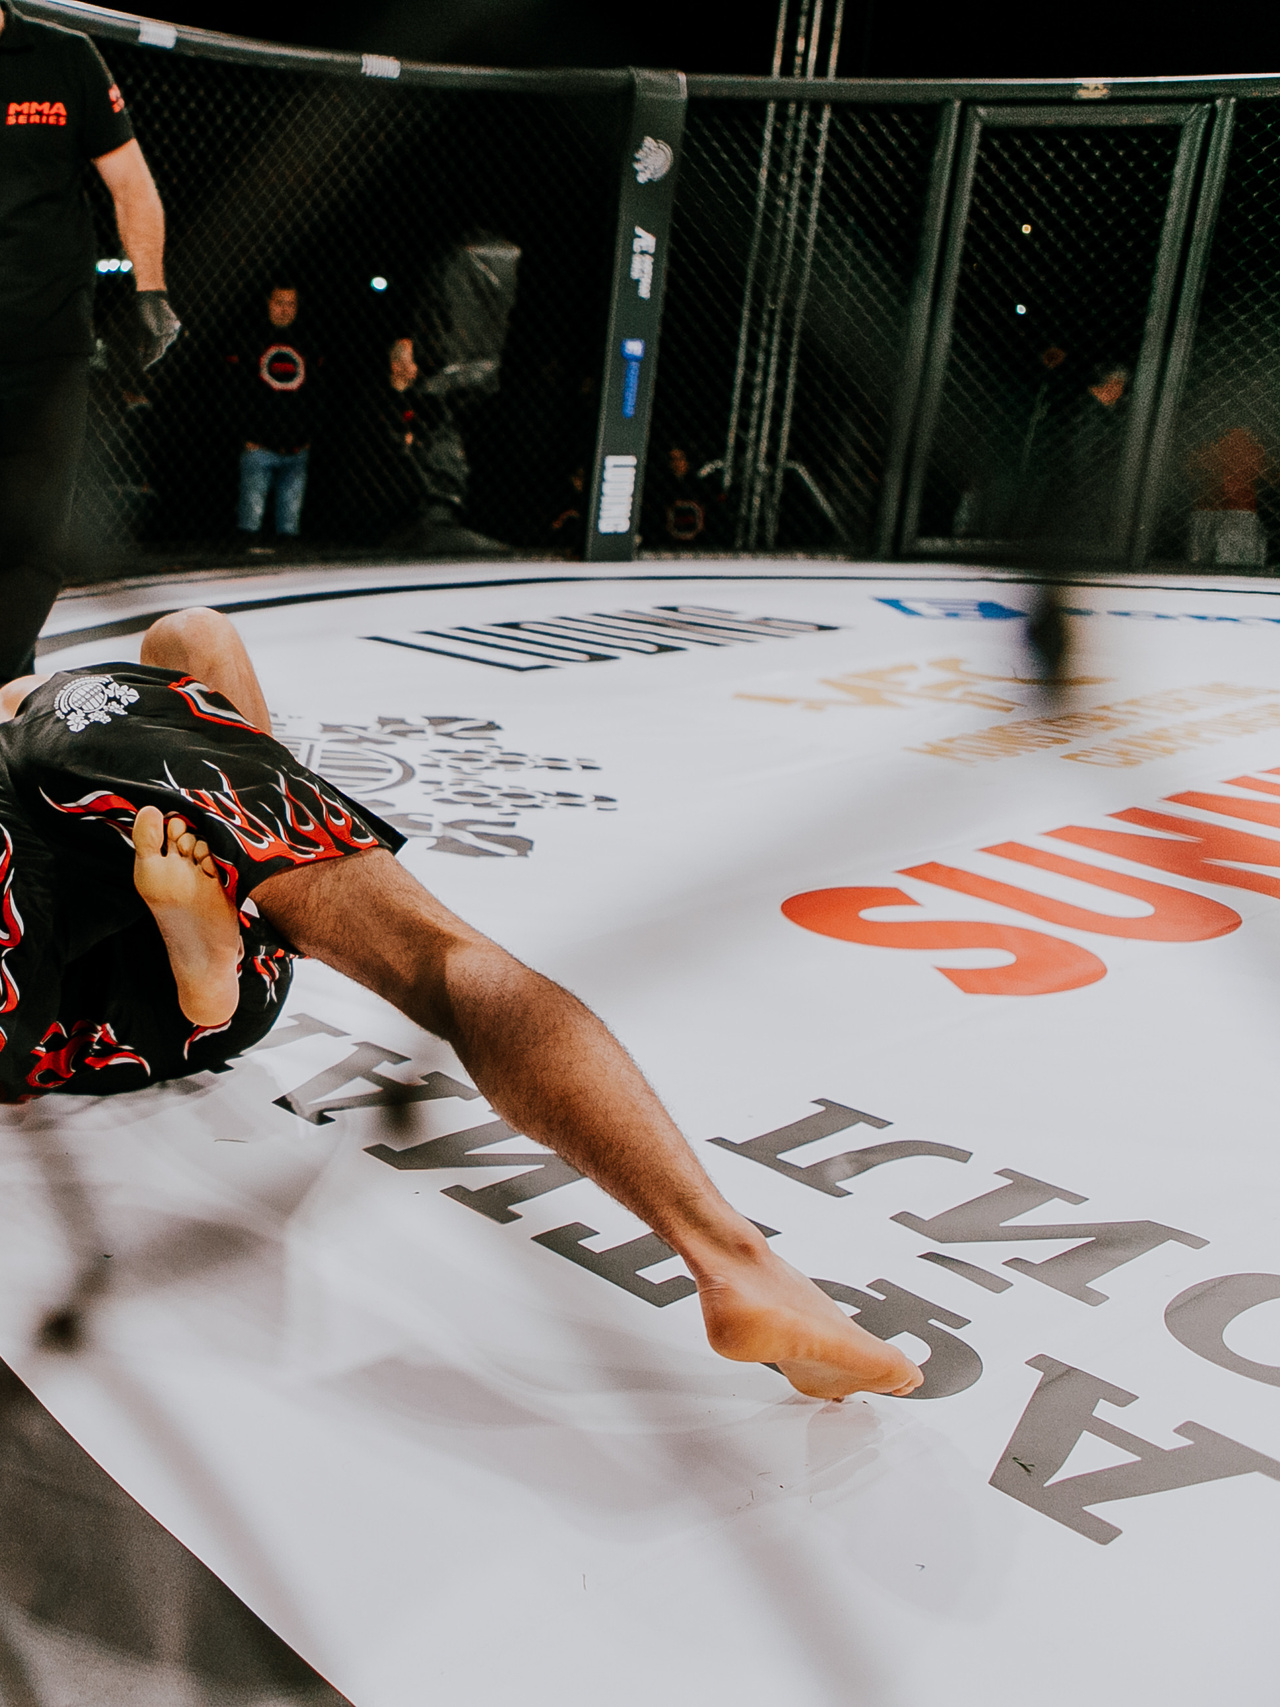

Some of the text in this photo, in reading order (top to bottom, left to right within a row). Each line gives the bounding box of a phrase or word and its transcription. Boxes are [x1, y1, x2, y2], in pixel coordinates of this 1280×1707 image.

[6, 114, 66, 126] SERIES
[7, 101, 67, 115] MMA
[360, 605, 841, 672] LUDING
[781, 768, 1280, 995] SUN
